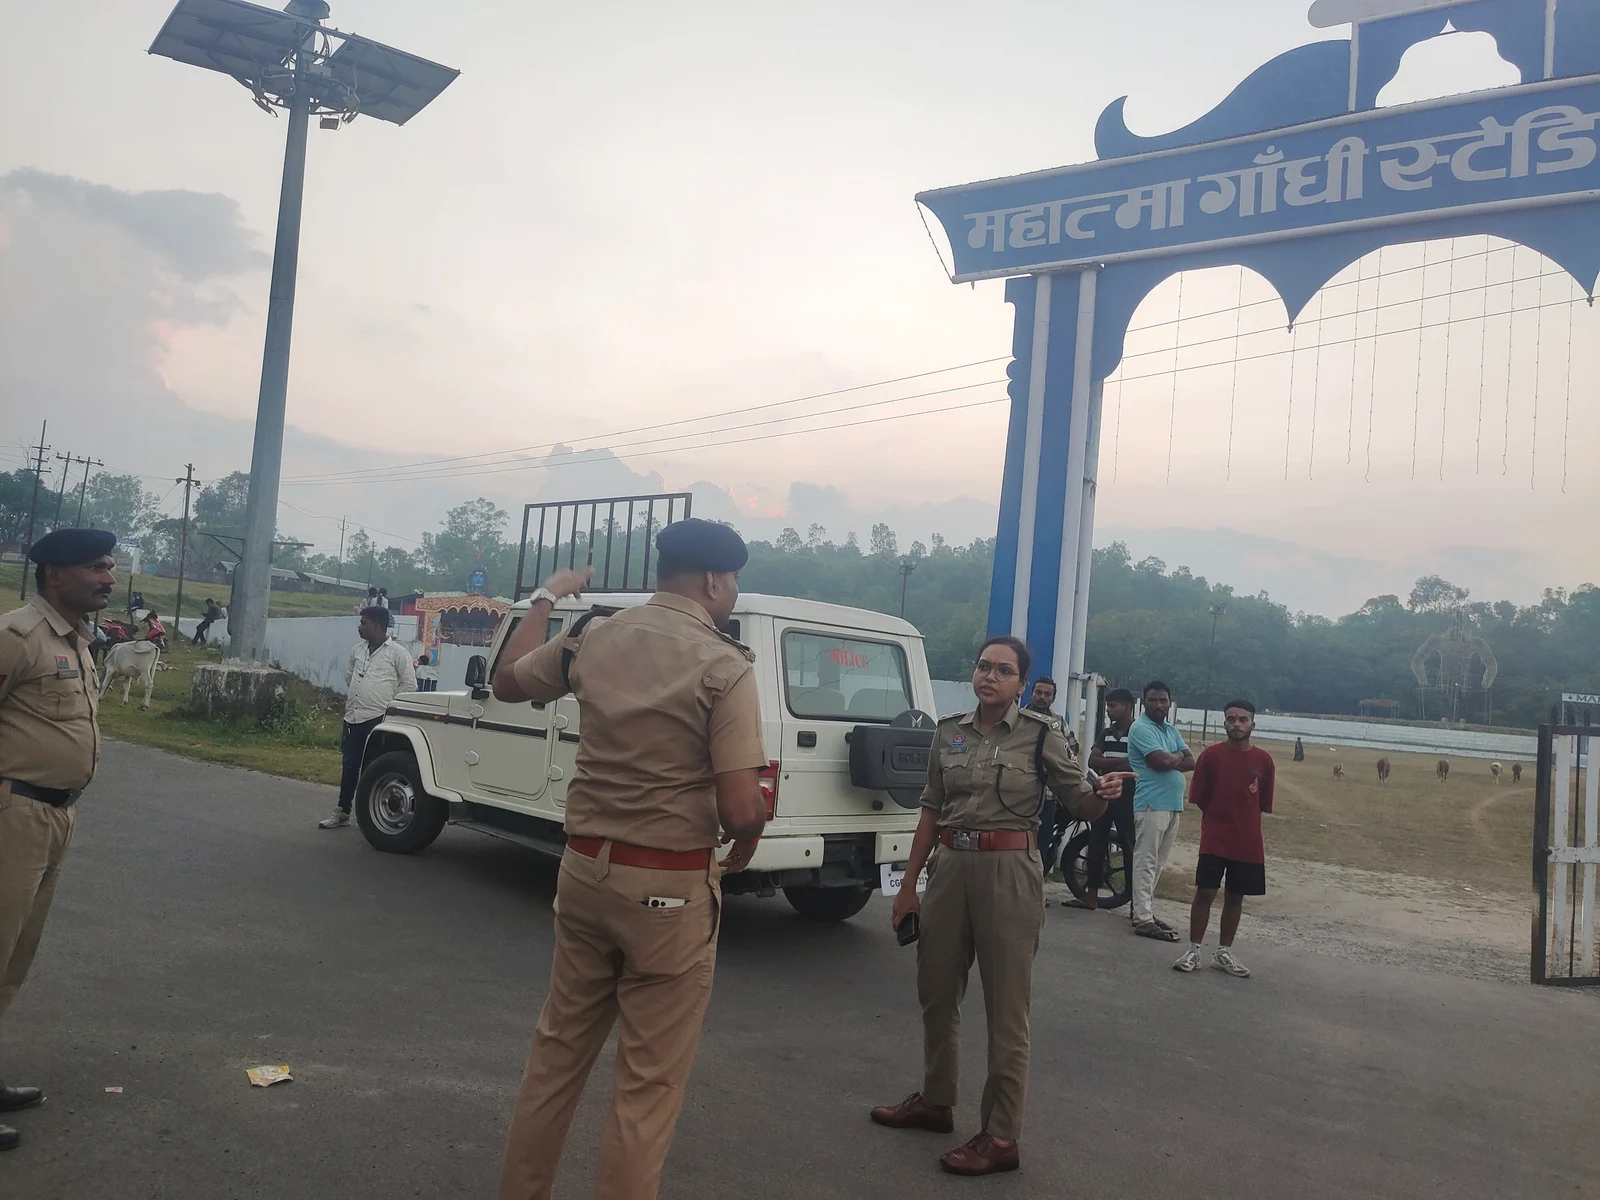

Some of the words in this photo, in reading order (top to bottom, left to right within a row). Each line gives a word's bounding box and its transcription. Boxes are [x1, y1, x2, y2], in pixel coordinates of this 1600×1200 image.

[963, 178, 1192, 253] महात्मा
[829, 650, 869, 669] POLICE
[1576, 694, 1600, 703] MA
